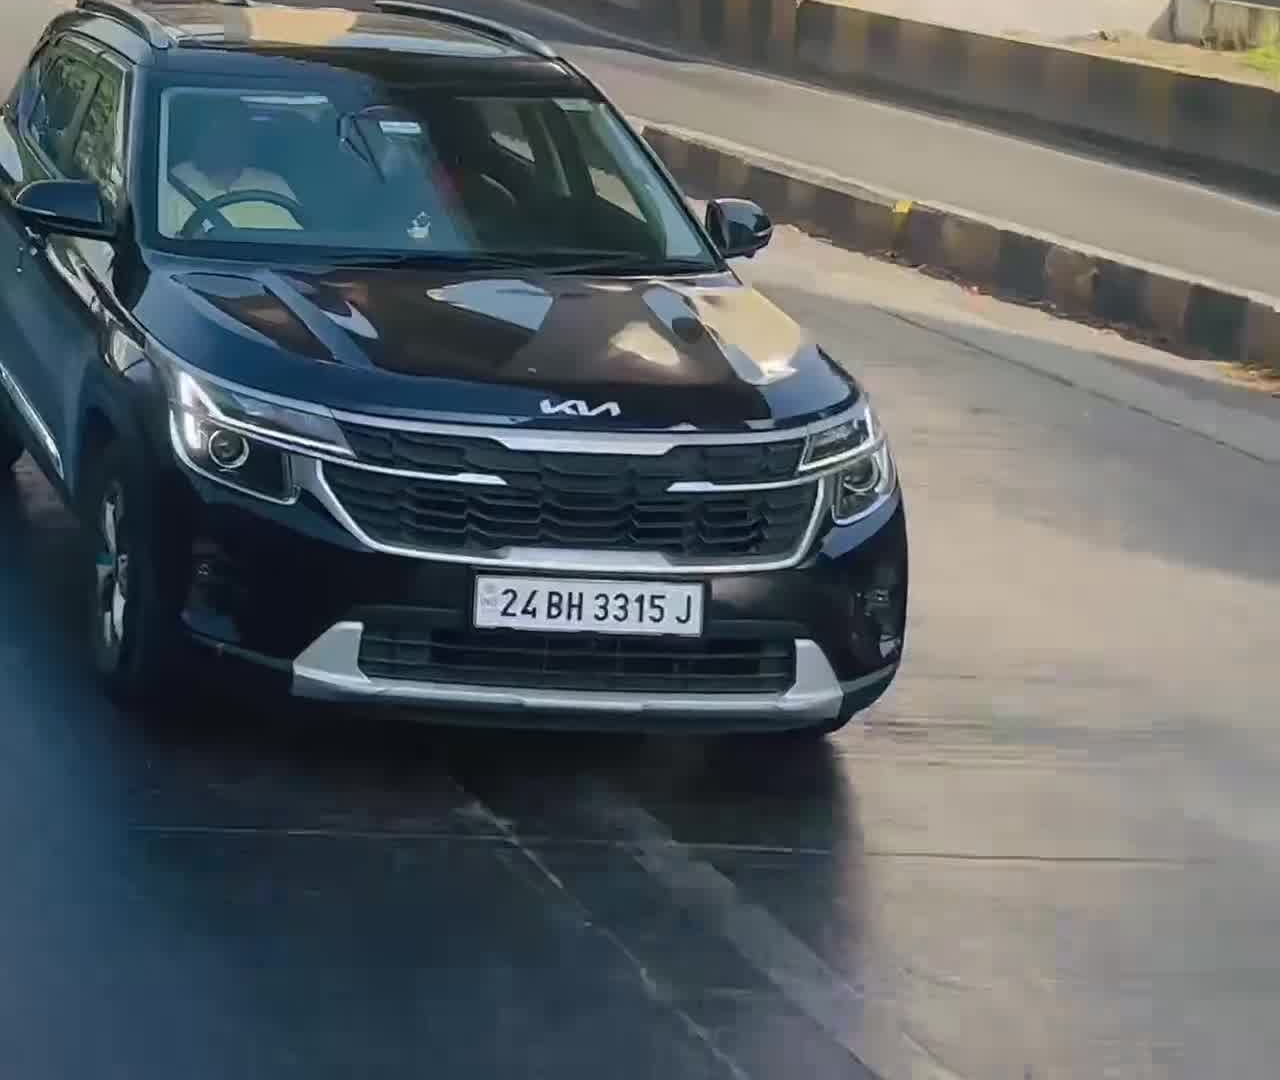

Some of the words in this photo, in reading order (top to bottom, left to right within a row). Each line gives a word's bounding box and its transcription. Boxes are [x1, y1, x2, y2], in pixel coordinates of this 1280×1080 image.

[539, 399, 620, 417] KIA
[500, 588, 539, 619] 24
[546, 591, 584, 621] BH
[593, 593, 667, 623] 3315
[675, 595, 692, 624] J
